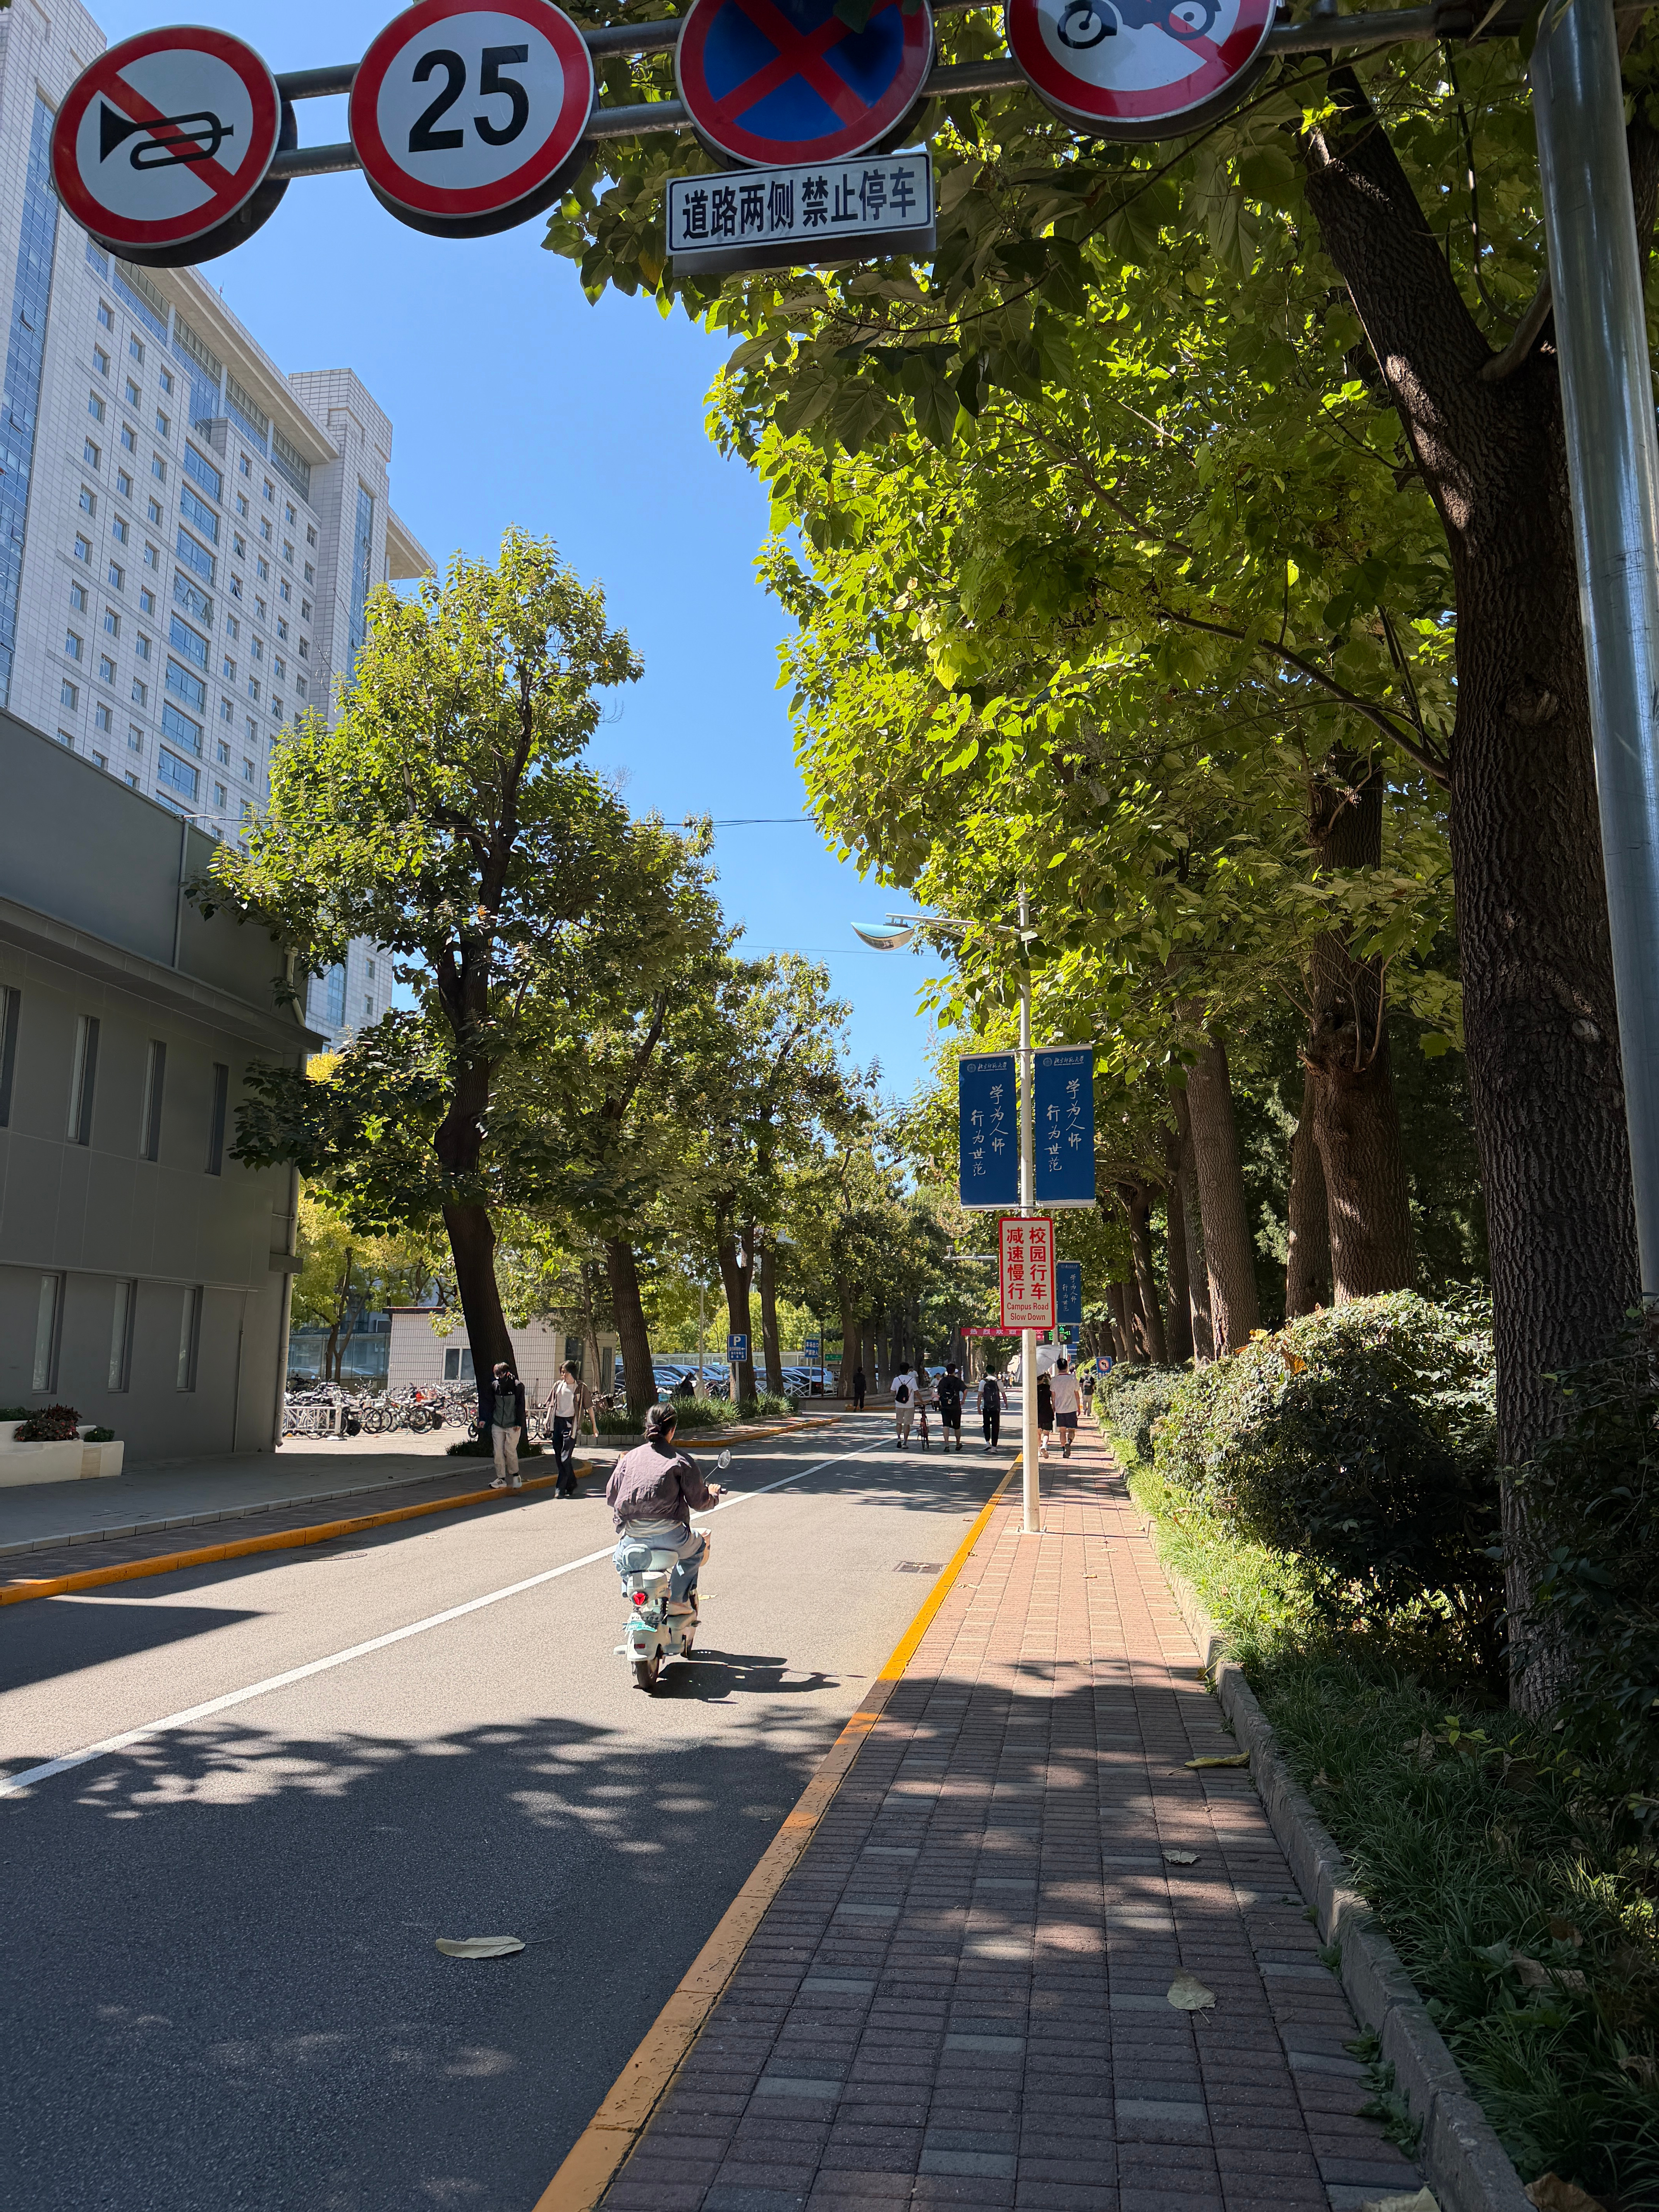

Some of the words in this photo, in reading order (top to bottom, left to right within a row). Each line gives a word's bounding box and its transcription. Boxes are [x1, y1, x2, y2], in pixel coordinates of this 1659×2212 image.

[409, 44, 529, 153] 25
[968, 1109, 986, 1176] 行为世范
[989, 1084, 1009, 1155] 学为人师
[1044, 1104, 1062, 1172] 行为世范
[1066, 1078, 1085, 1151] 学为人师
[1006, 1227, 1025, 1300] 减速慢行
[1029, 1227, 1047, 1300] 校园行车
[733, 1336, 741, 1346] P
[1007, 1302, 1032, 1311] Campus
